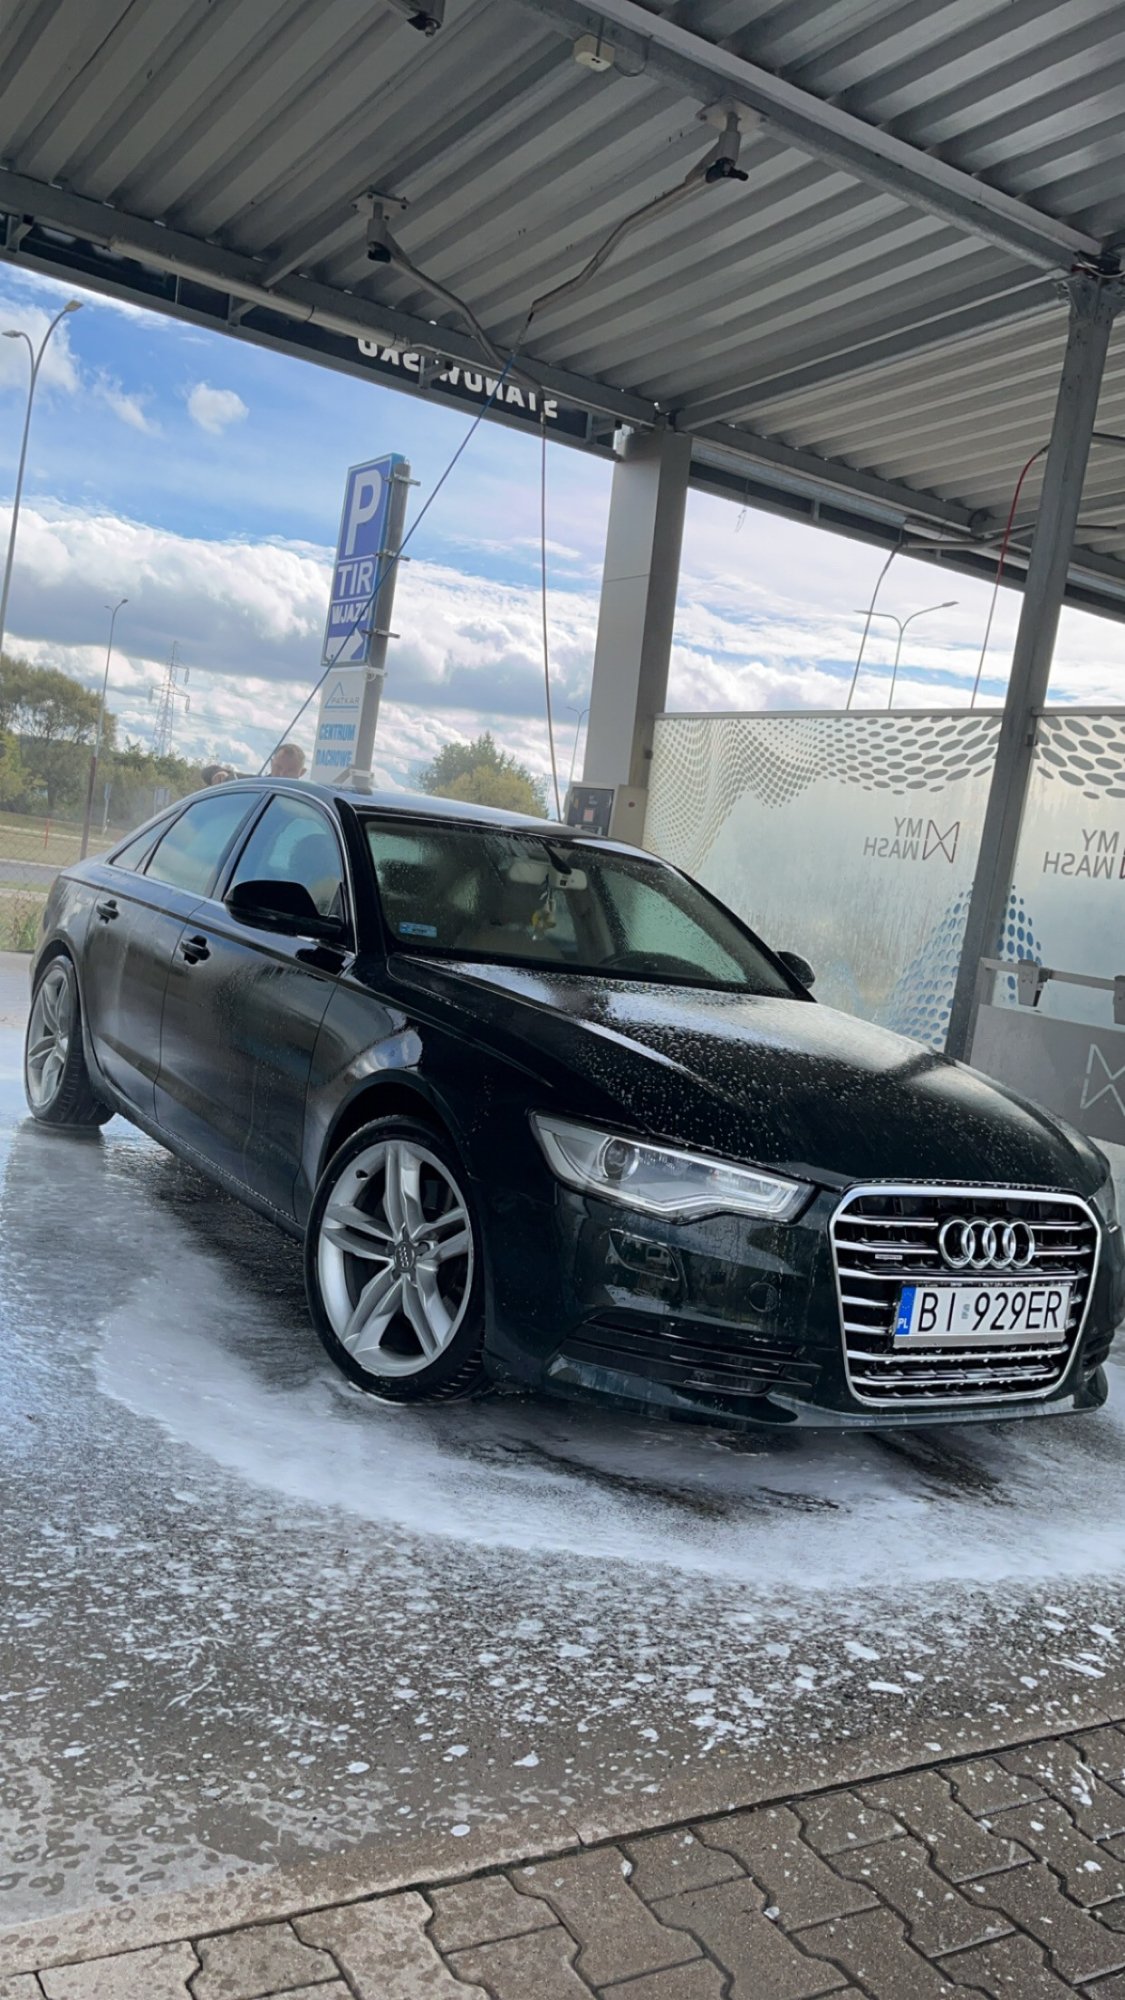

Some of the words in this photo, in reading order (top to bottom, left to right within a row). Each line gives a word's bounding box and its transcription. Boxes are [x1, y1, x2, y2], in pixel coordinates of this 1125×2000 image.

[345, 469, 382, 556] P
[338, 561, 373, 597] TIR
[320, 723, 355, 740] CENTRUM
[897, 1317, 908, 1329] PL
[918, 1292, 956, 1332] BI
[972, 1290, 1062, 1331] 929ER
